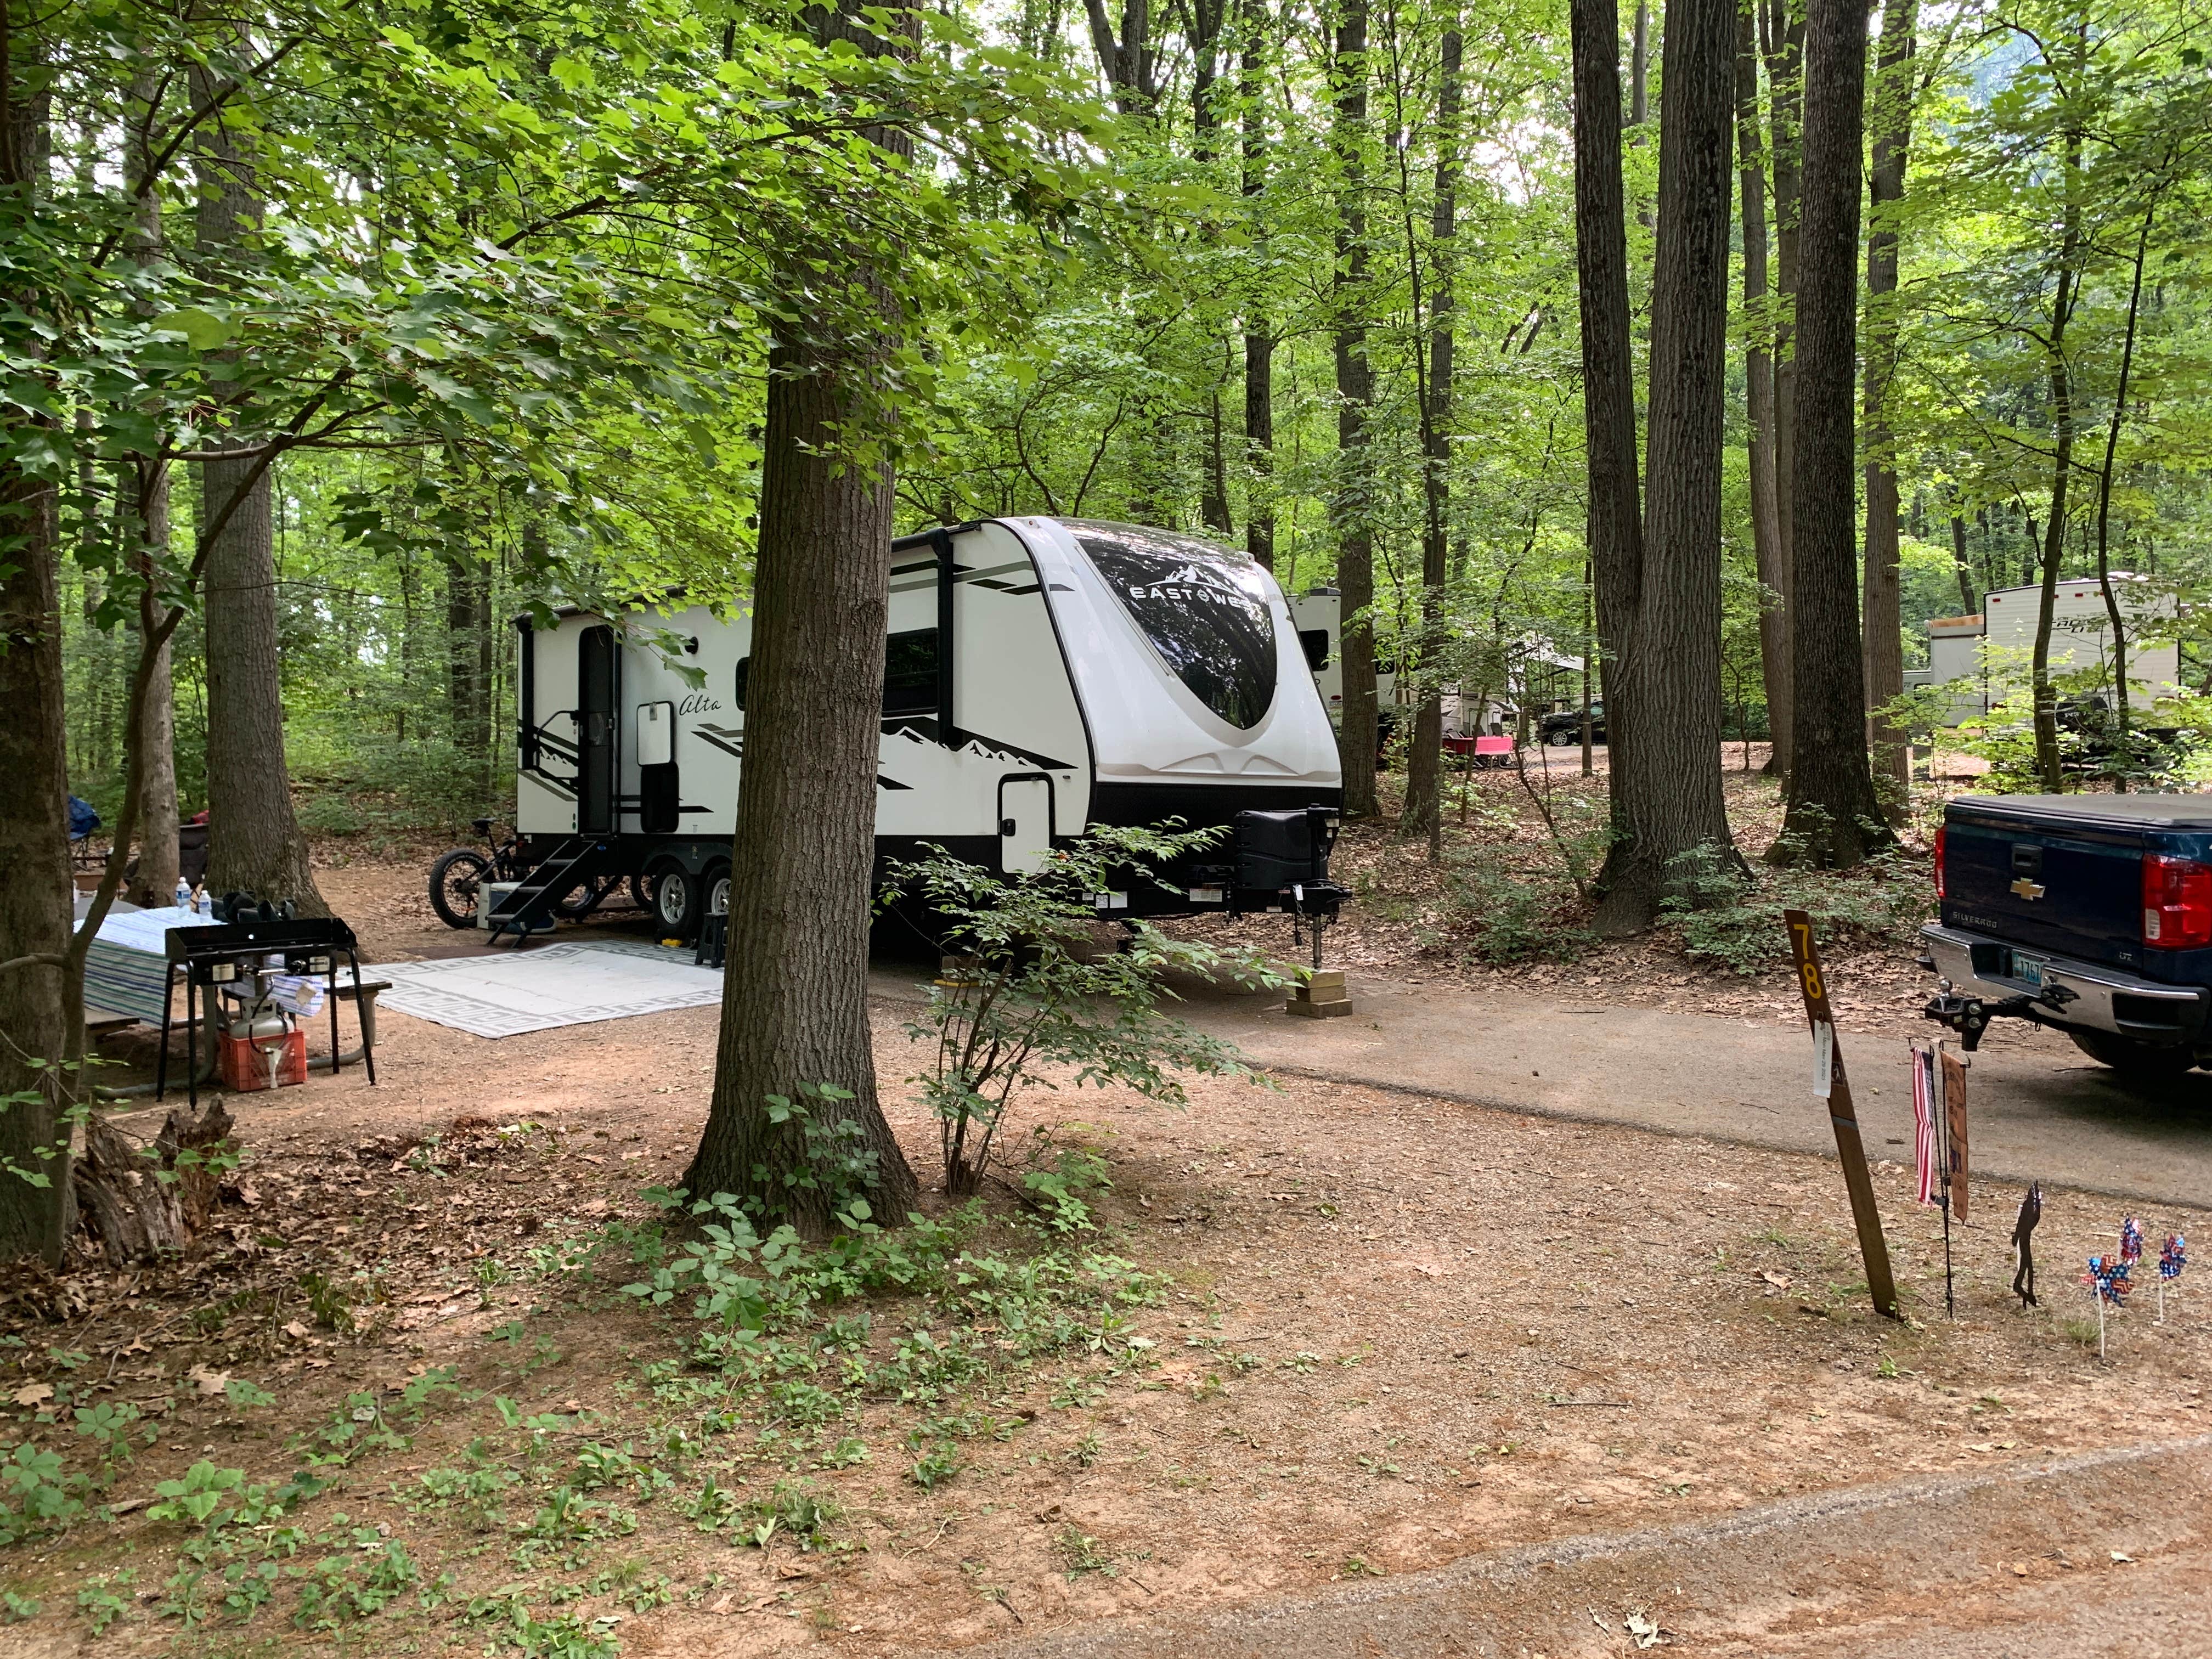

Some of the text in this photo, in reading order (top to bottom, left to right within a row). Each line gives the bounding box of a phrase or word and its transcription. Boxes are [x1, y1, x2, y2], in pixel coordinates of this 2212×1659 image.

[1129, 587, 1261, 612] EAST WEST
[679, 694, 722, 716] Alta
[1953, 911, 1997, 928] SILVERADO
